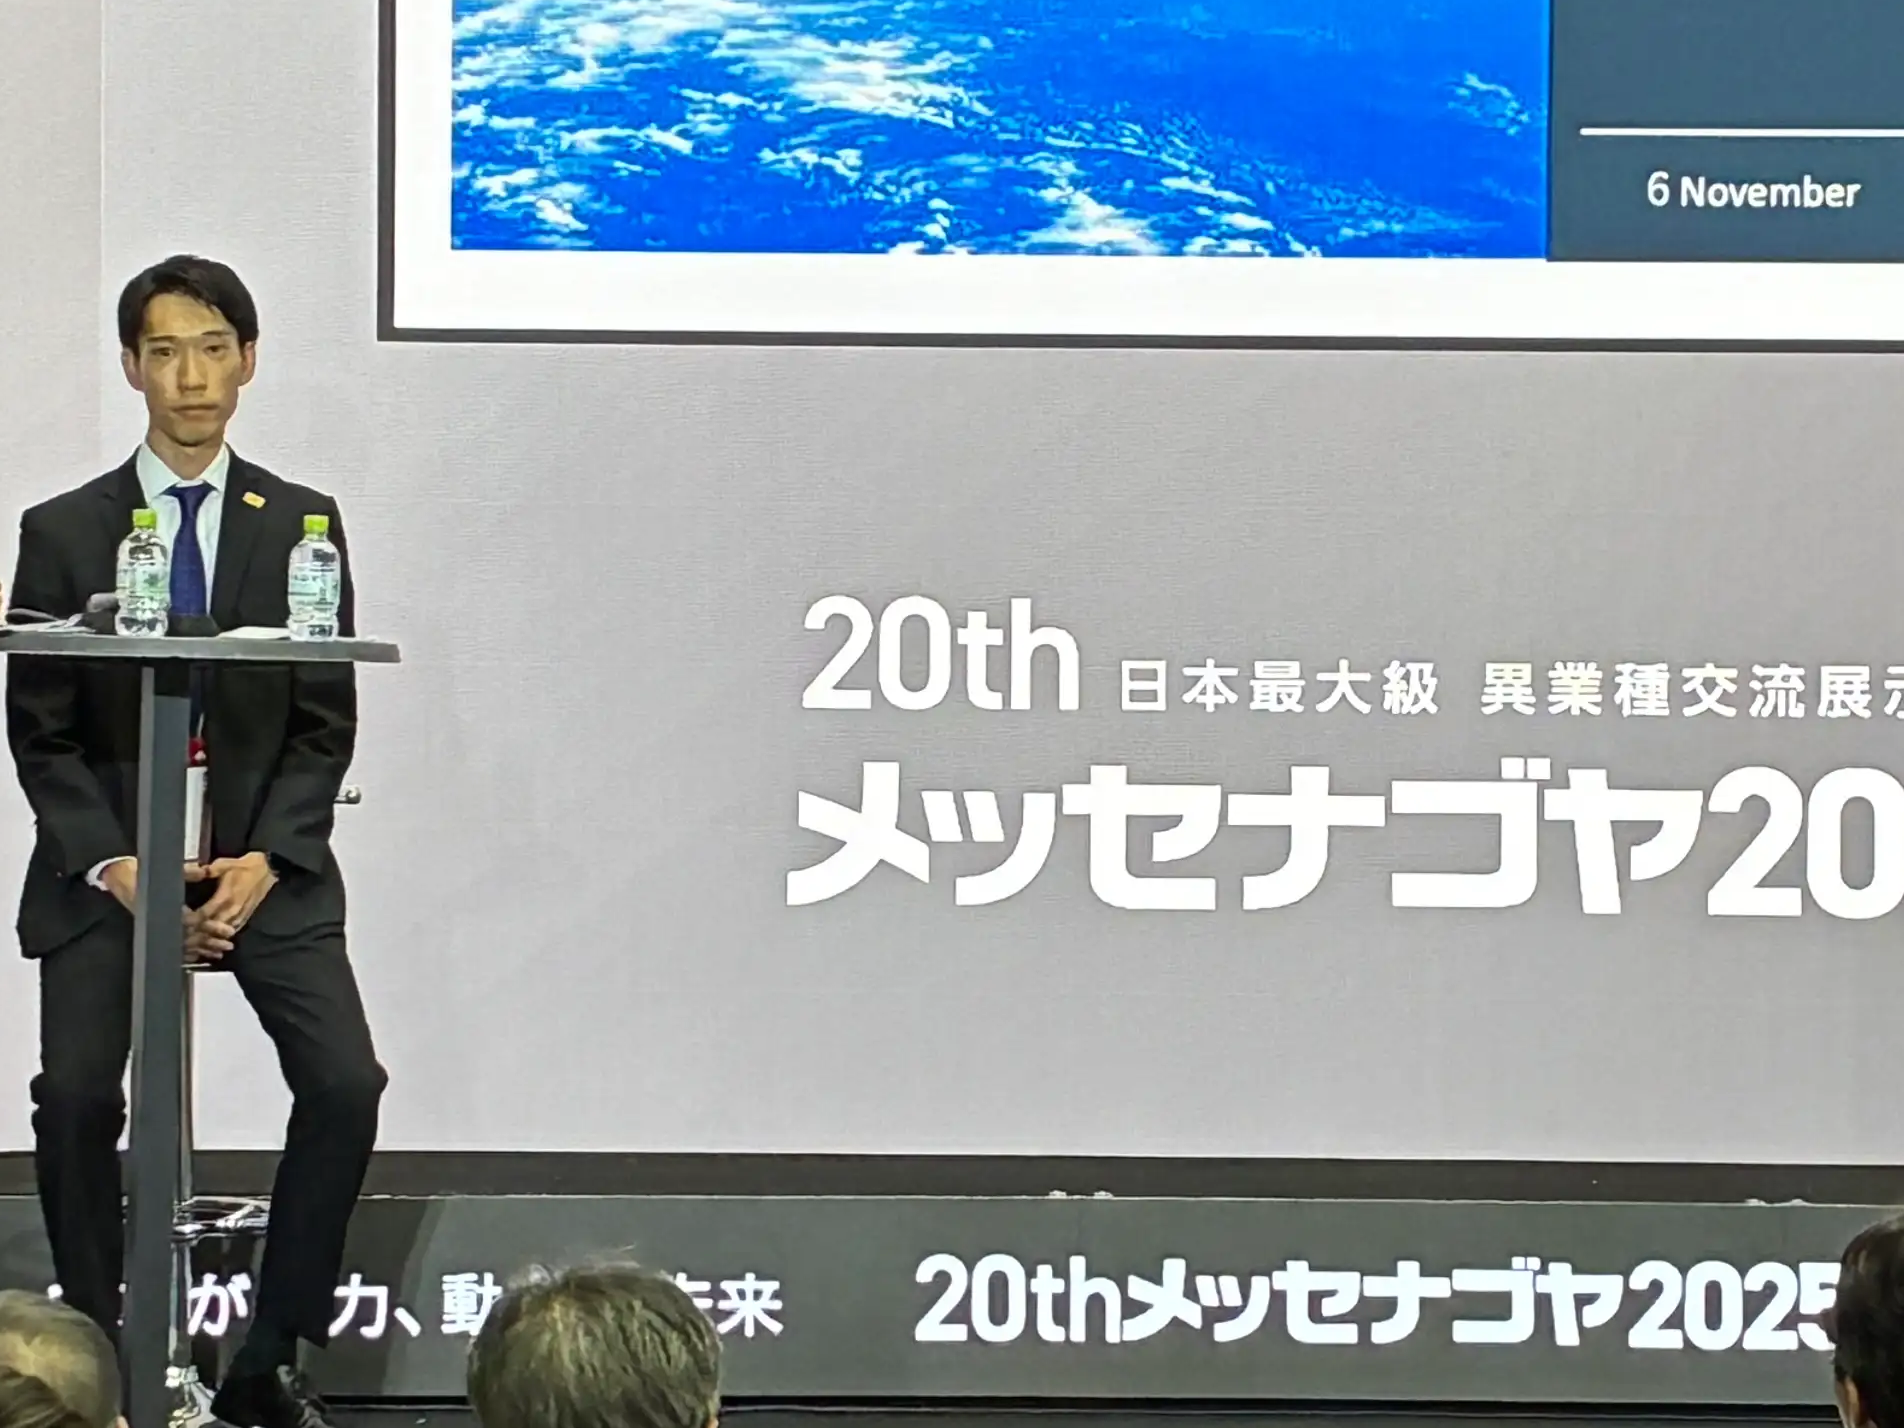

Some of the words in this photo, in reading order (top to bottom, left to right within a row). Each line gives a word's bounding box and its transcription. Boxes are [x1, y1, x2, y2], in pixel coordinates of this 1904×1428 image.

[1647, 170, 1670, 207] 6
[1680, 174, 1862, 208] November
[802, 595, 1079, 711] 20th
[1119, 658, 1439, 716] 日本最大級
[914, 1253, 1842, 1351] 20thメッセナゴヤ2025
